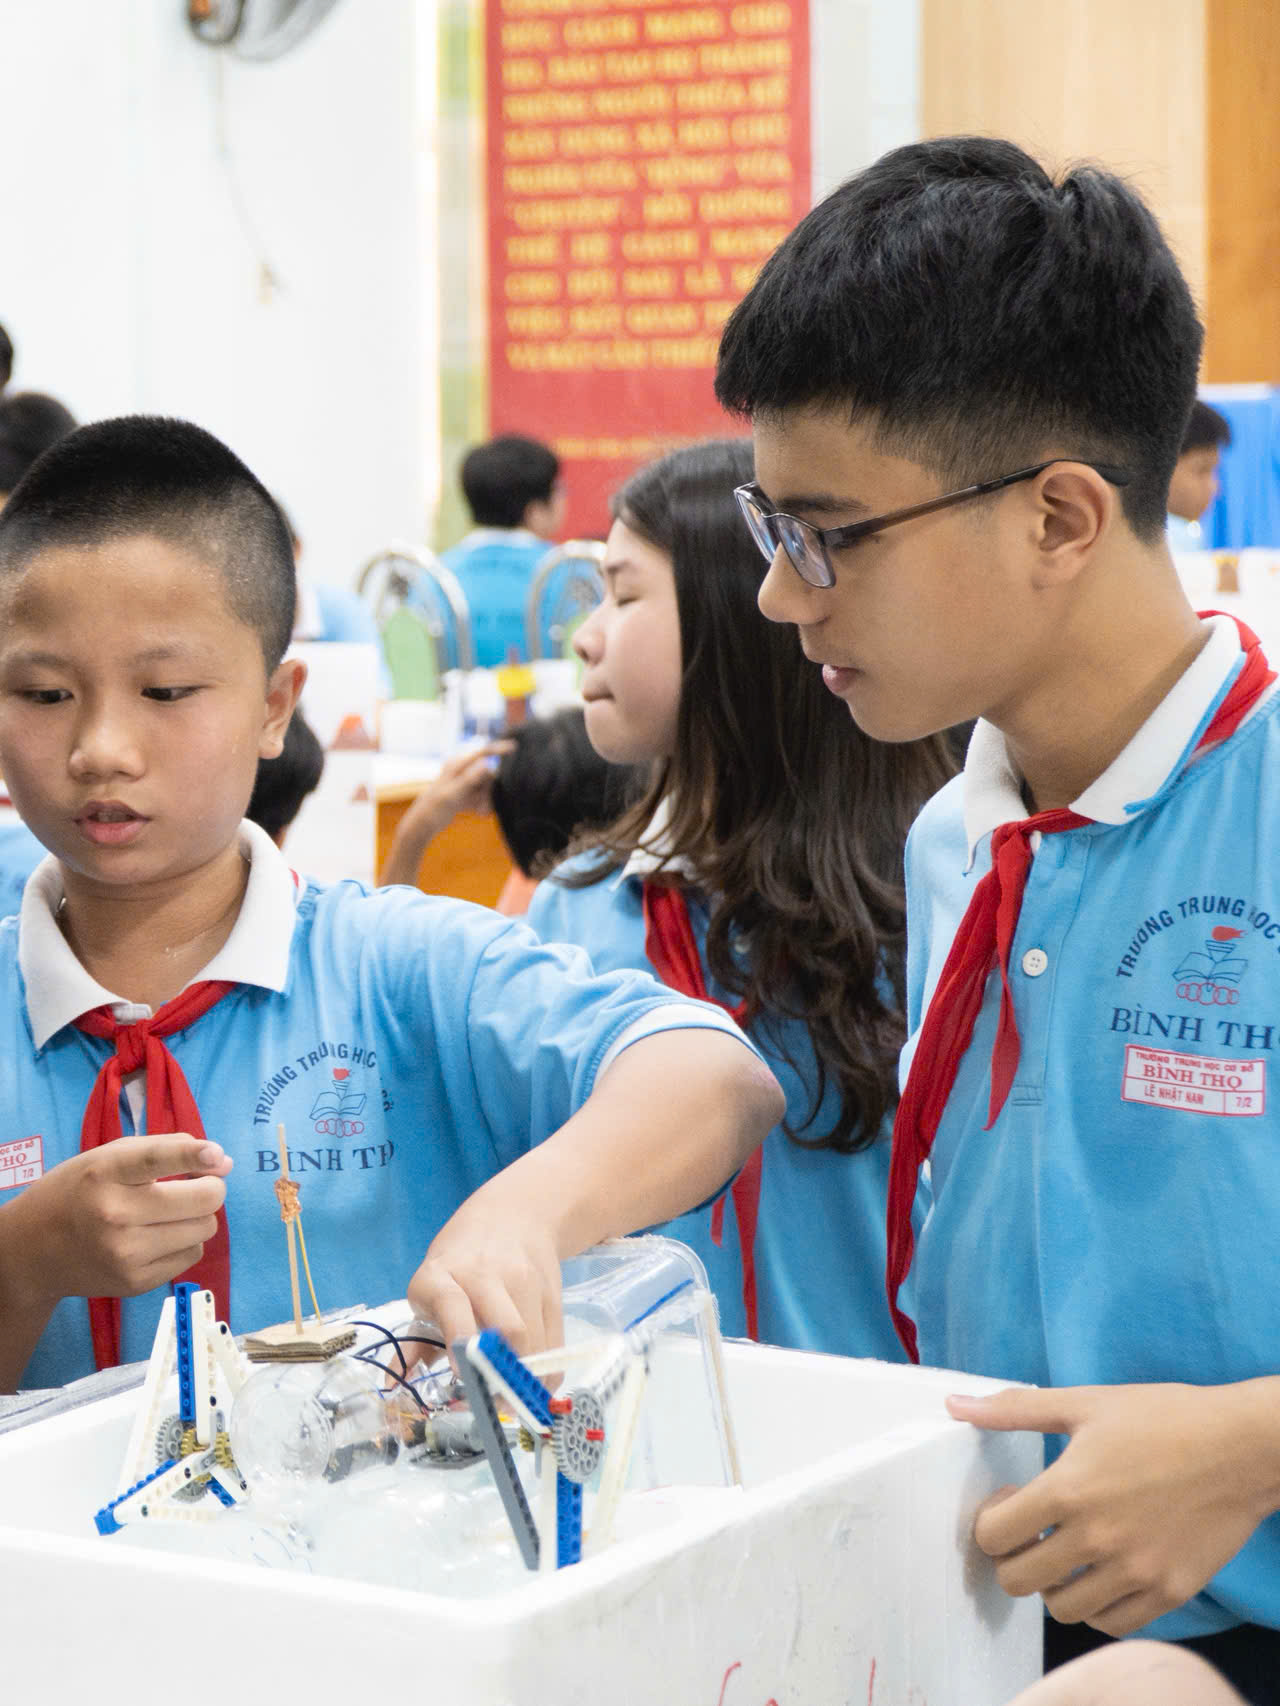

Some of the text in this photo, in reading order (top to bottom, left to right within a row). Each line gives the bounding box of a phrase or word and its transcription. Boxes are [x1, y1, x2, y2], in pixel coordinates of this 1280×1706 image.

[1178, 896, 1246, 919] TRUNG
[1110, 1003, 1280, 1049] BÌNH TH
[1144, 1063, 1242, 1091] BÌNH THỌ
[256, 1145, 344, 1172] BÌNH
